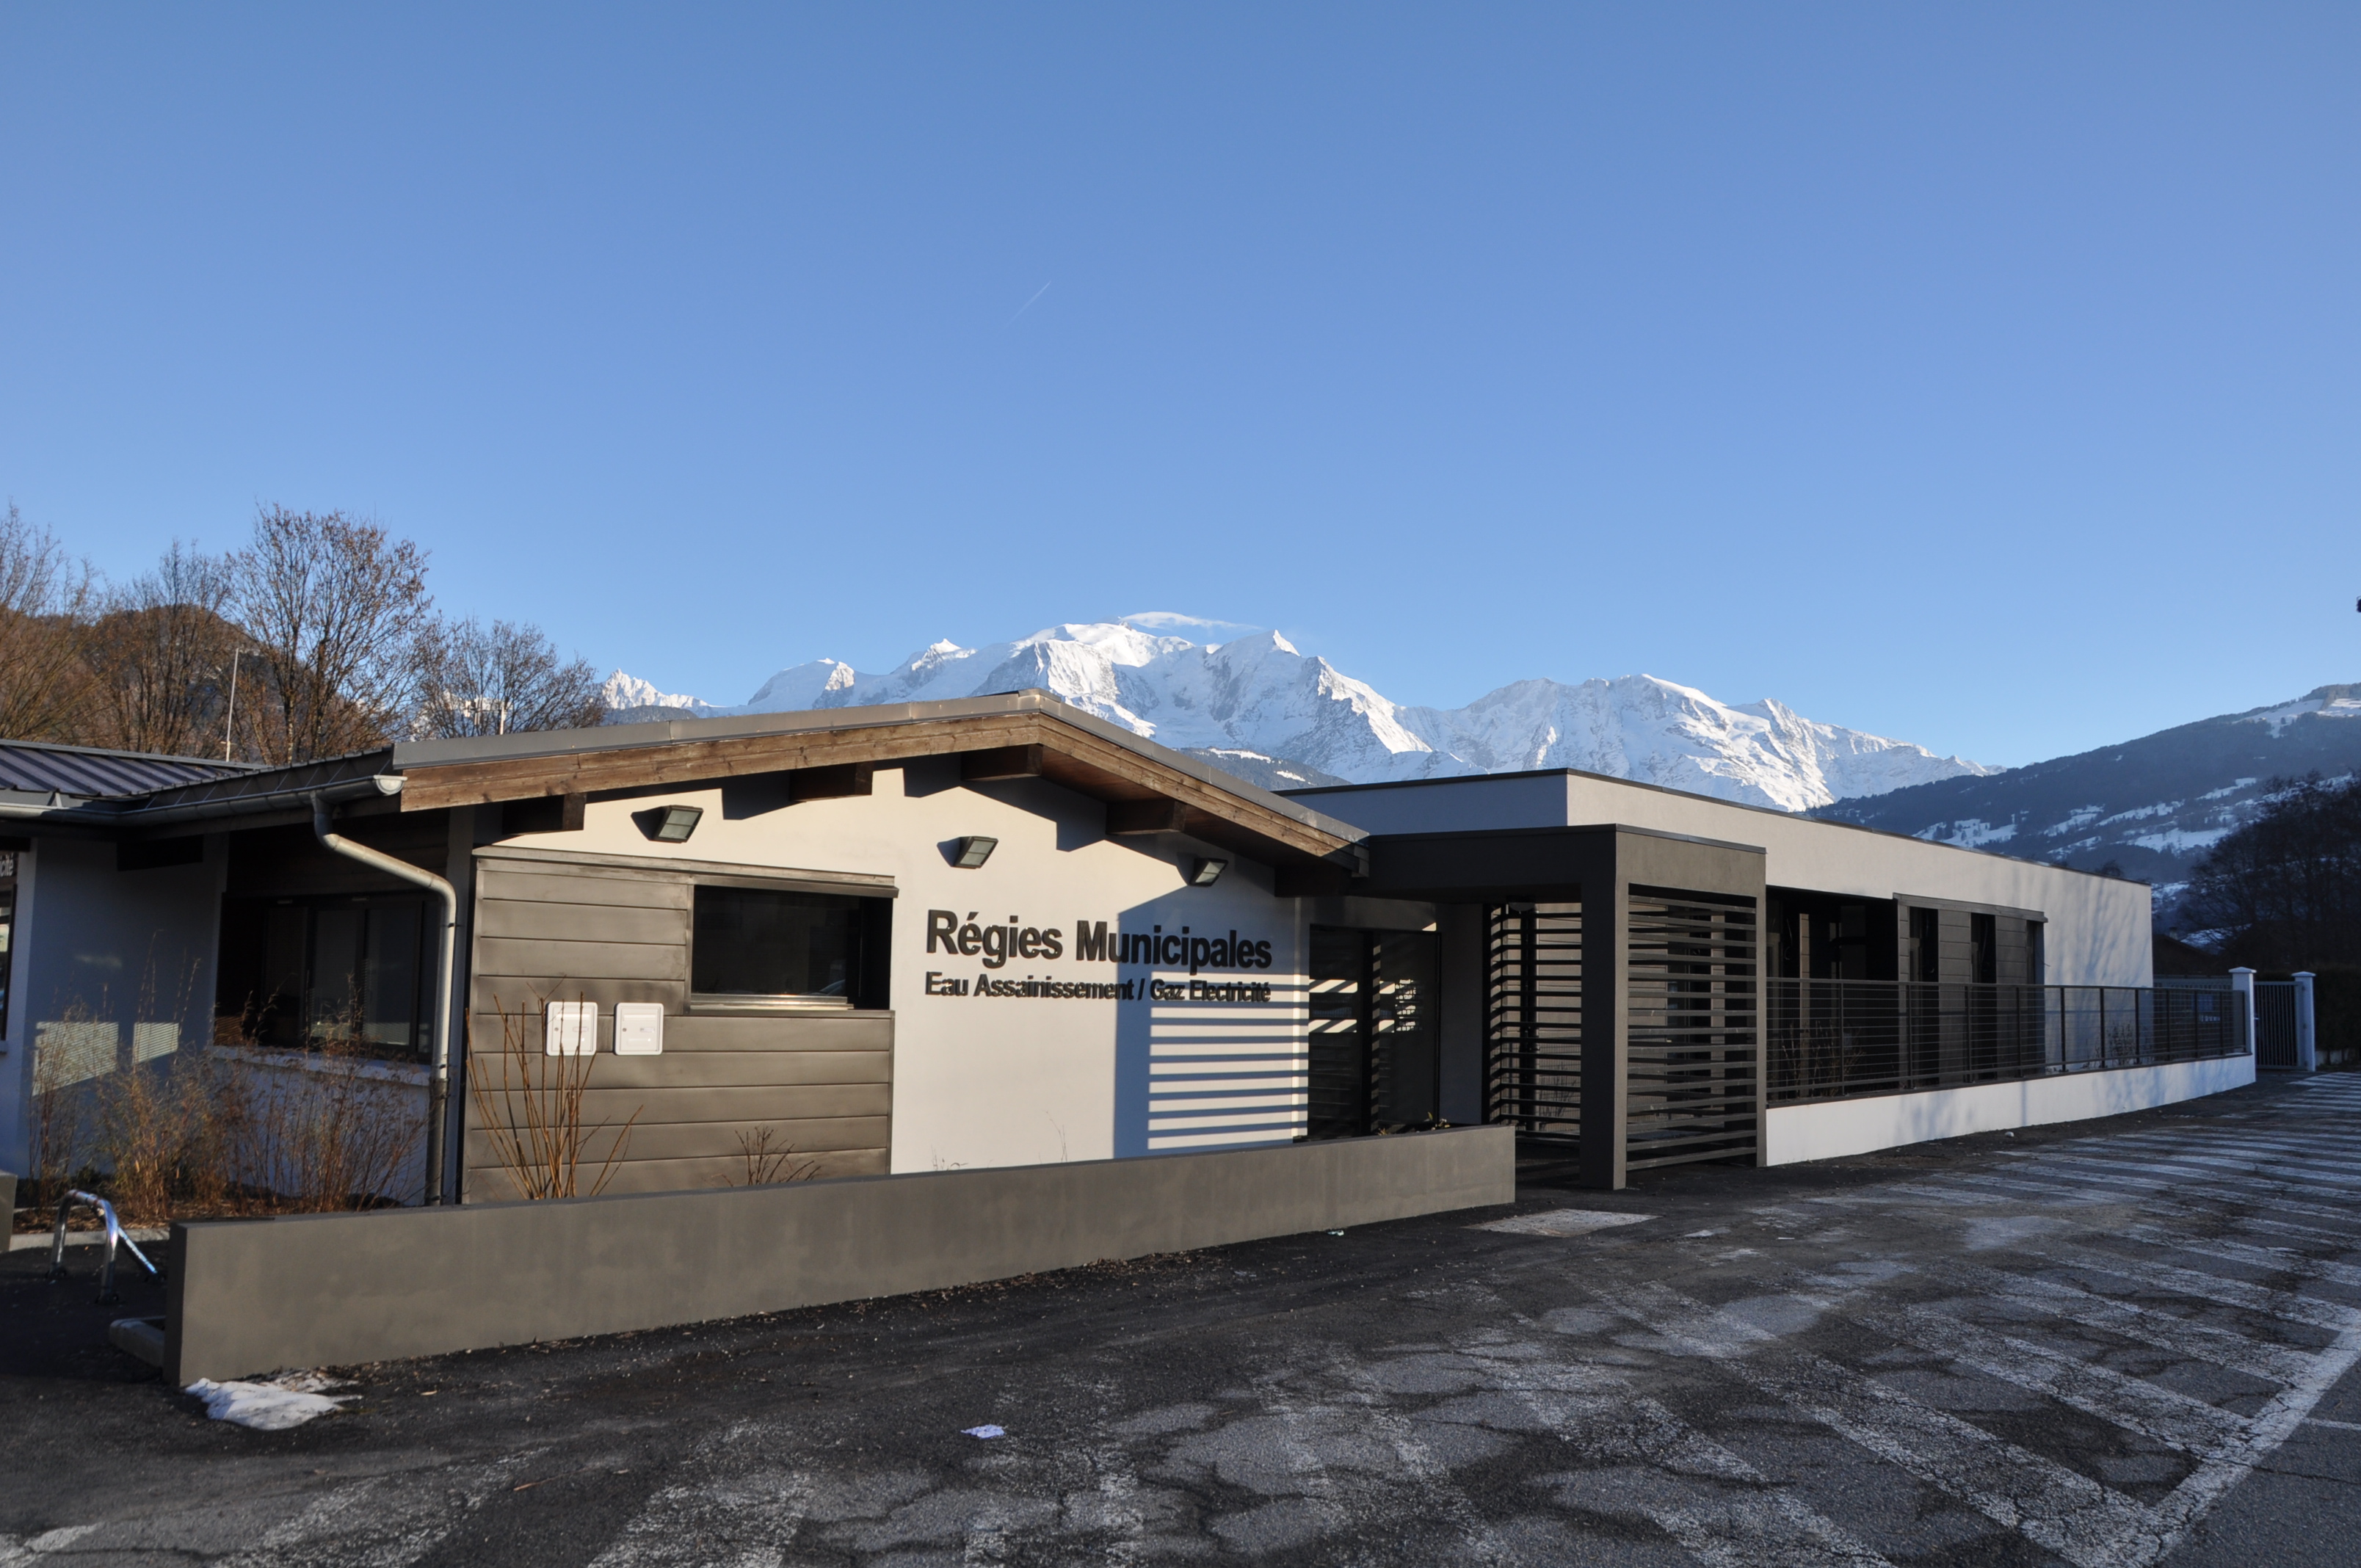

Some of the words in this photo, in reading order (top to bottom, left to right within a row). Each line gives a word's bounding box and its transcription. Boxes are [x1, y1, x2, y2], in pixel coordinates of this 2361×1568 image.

[926, 909, 1063, 969] Régies
[1076, 920, 1272, 976] Municipales
[925, 971, 968, 996] Eau
[973, 973, 1134, 1001] Assainissement
[1137, 978, 1145, 1001] /
[1150, 979, 1185, 1000] Gaz
[1189, 979, 1272, 1002] Electricité
